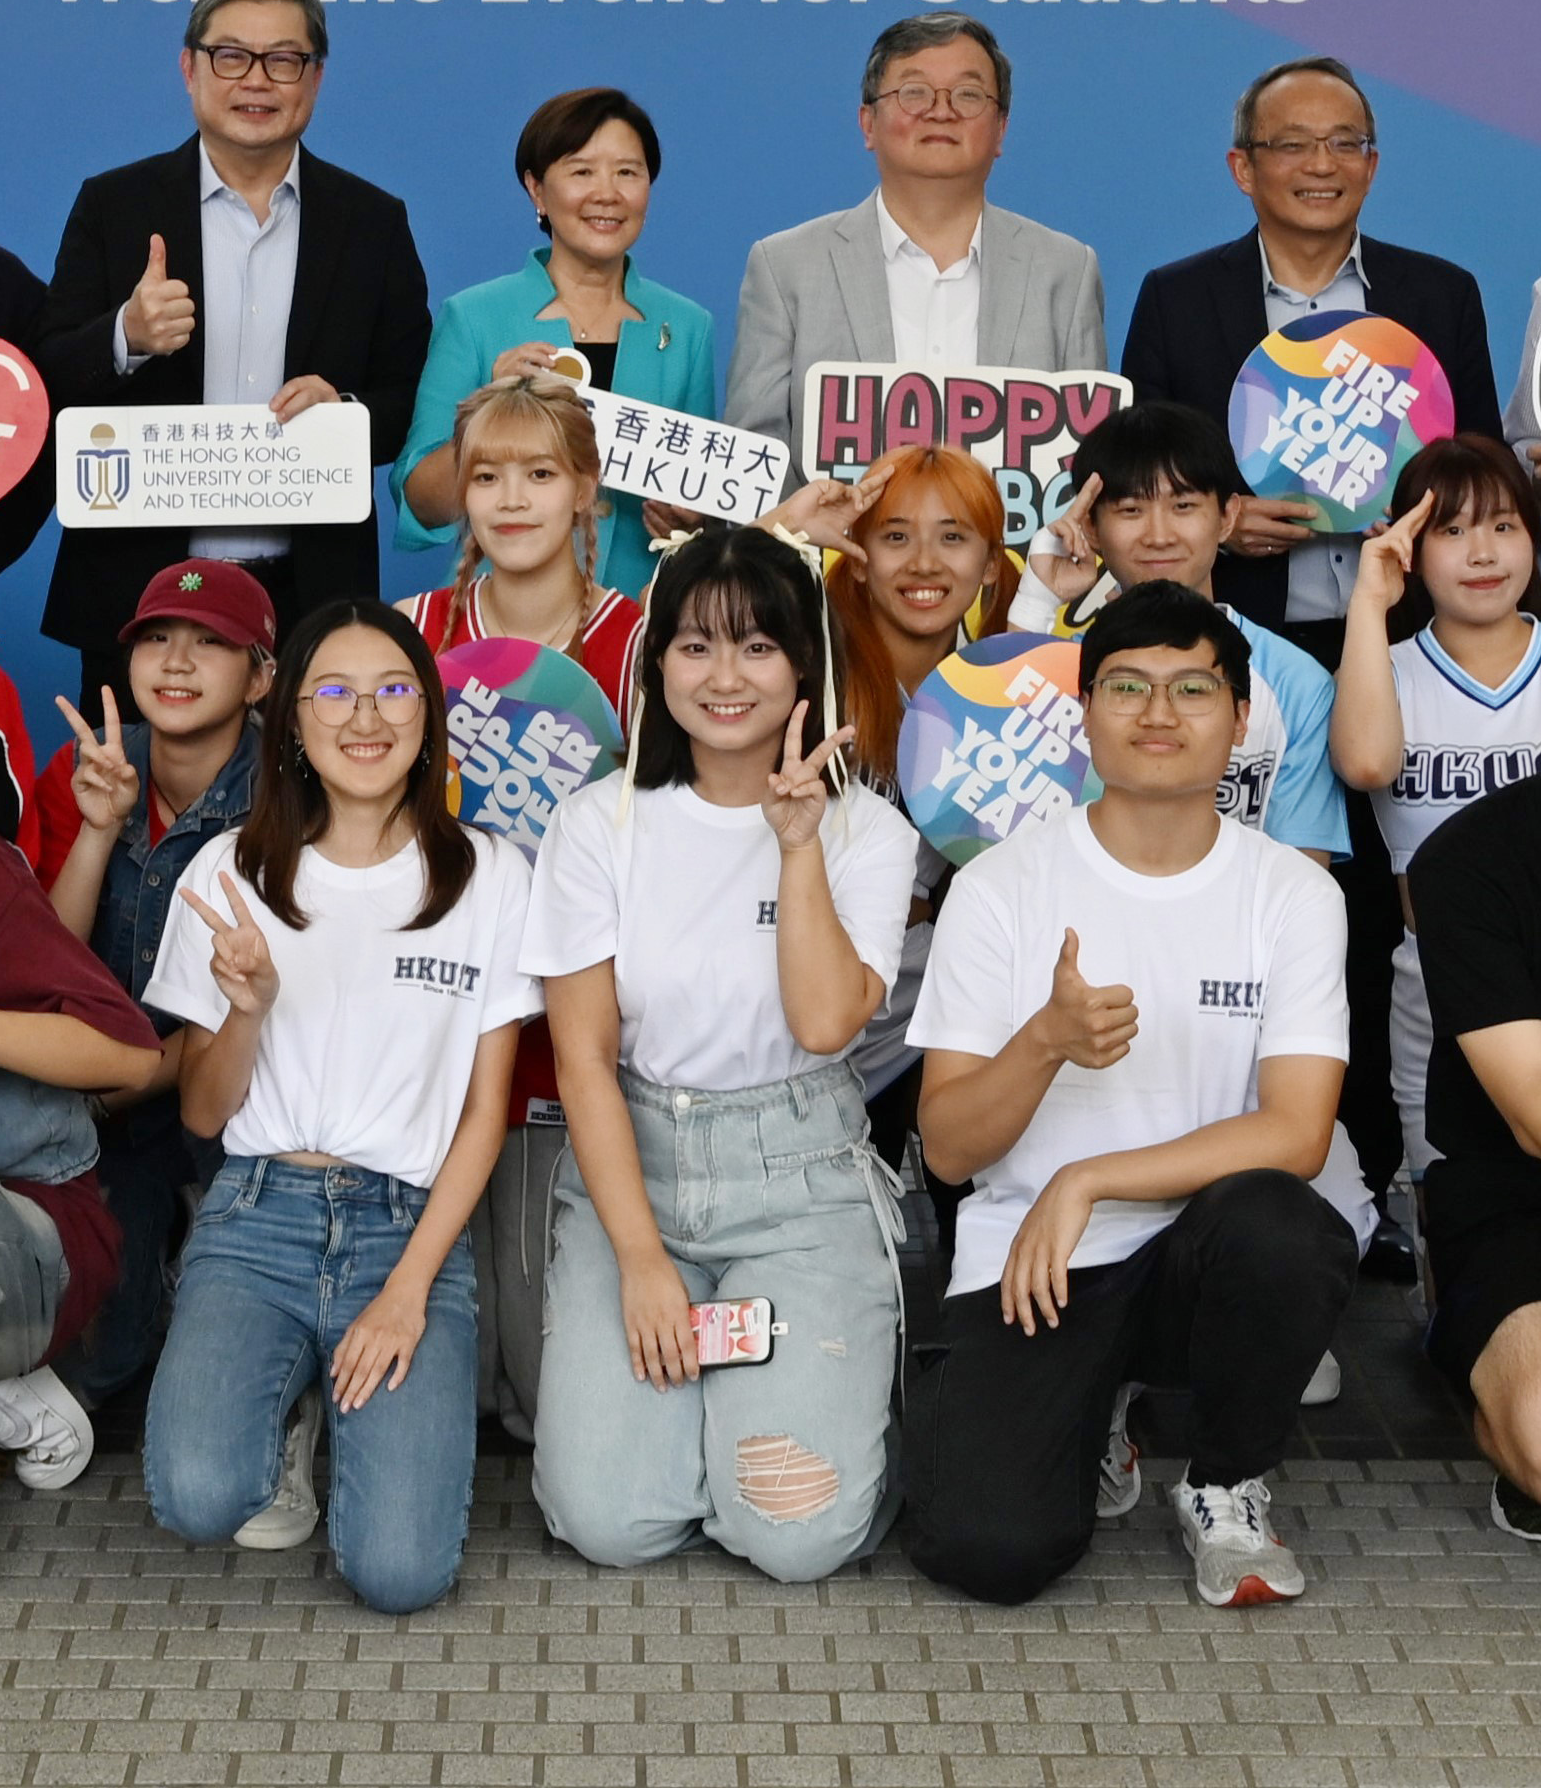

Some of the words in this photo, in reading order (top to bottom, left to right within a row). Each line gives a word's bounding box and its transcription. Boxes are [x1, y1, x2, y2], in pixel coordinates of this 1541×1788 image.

[1319, 375, 1385, 429] UP
[1321, 338, 1421, 421] FIRE
[143, 423, 285, 442] 香港科技大學
[143, 448, 174, 465] THE
[180, 447, 237, 464] HONG
[244, 446, 302, 463] KONG
[614, 404, 783, 482] 香港科大
[816, 371, 1122, 474] HAPPY
[1278, 386, 1388, 485] YOUR
[143, 470, 241, 488] UNIVERSITY
[247, 469, 273, 486] OF
[278, 467, 353, 485] SCIENCE
[143, 493, 185, 510] AND
[189, 491, 315, 509] TECHNOLOGY
[603, 445, 776, 520] HKUST
[1258, 414, 1369, 512] YEAR
[446, 675, 501, 786] IRE
[458, 715, 512, 787] UP
[953, 715, 1073, 819] YOUR
[999, 705, 1071, 767] UP
[472, 710, 571, 832] YOUR
